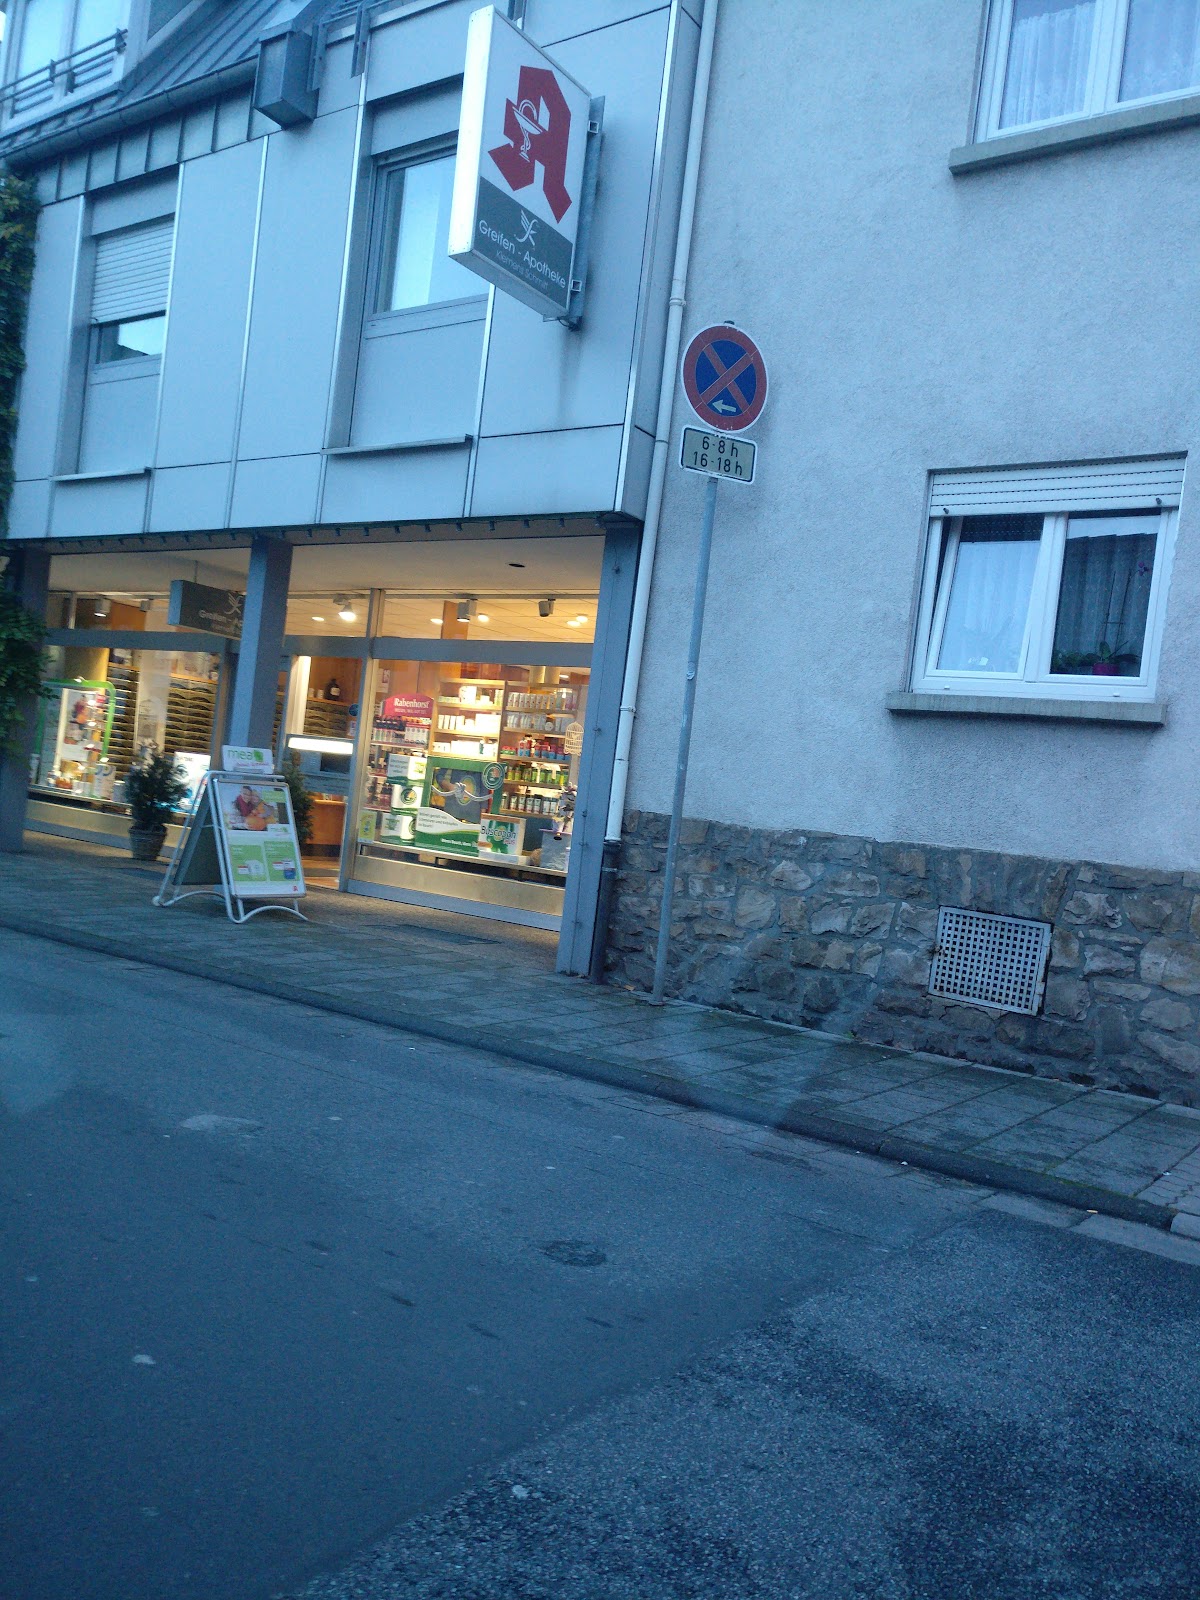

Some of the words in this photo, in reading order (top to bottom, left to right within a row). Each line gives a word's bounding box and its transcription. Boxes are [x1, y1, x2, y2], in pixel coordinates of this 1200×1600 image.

[479, 220, 515, 254] Greifen
[523, 250, 566, 289] Apotheke
[731, 442, 739, 458] h
[735, 464, 743, 476] h
[394, 697, 430, 709] Rabenhorst
[227, 749, 253, 760] mea
[480, 825, 517, 840] Buscopan
